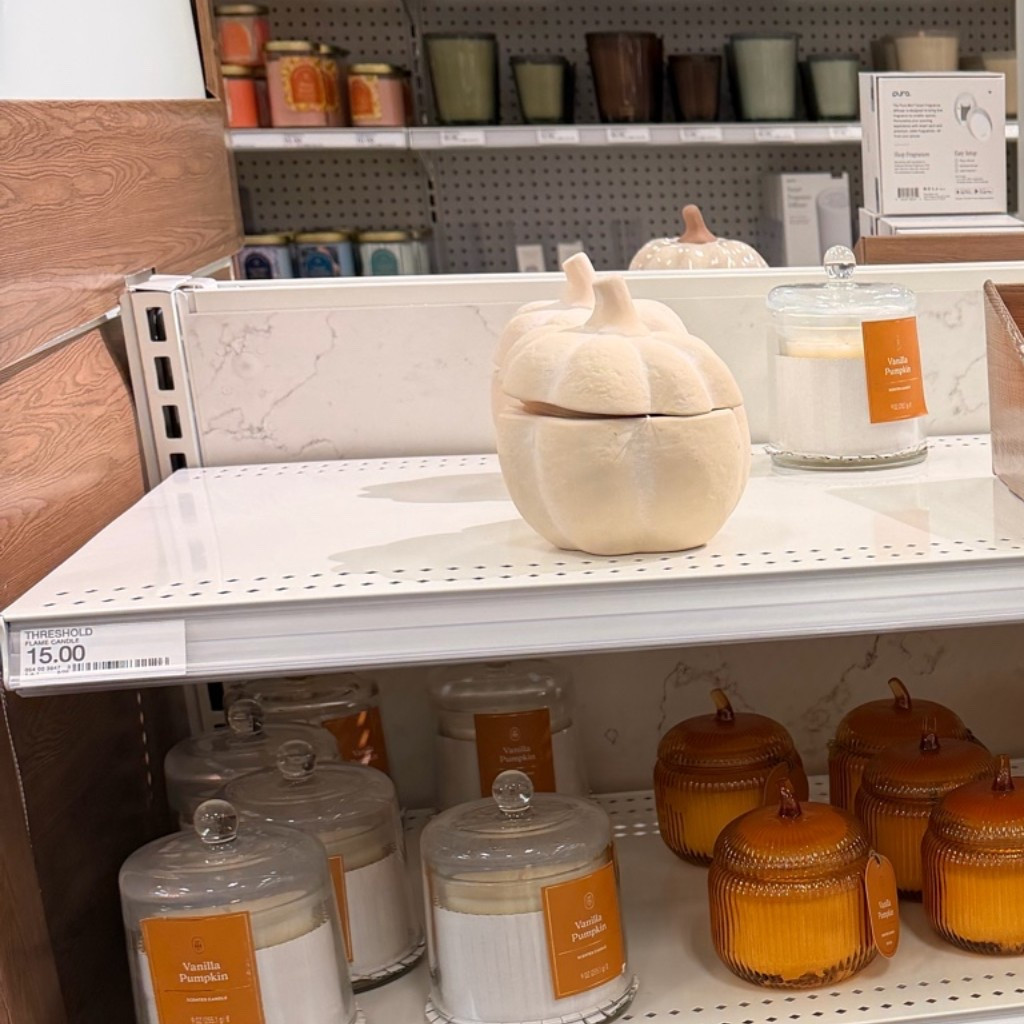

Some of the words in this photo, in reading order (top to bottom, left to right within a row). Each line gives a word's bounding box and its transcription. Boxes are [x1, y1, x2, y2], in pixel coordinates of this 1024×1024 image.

[888, 356, 908, 365] Vanilla
[884, 366, 911, 376] Pumpkin
[25, 628, 93, 640] THRESHOLD
[27, 645, 85, 664] 15.00
[574, 914, 602, 930] Vanilla
[572, 924, 607, 942] Pumpkin
[183, 961, 220, 972] Vanilla
[180, 972, 228, 983] Pumpkin
